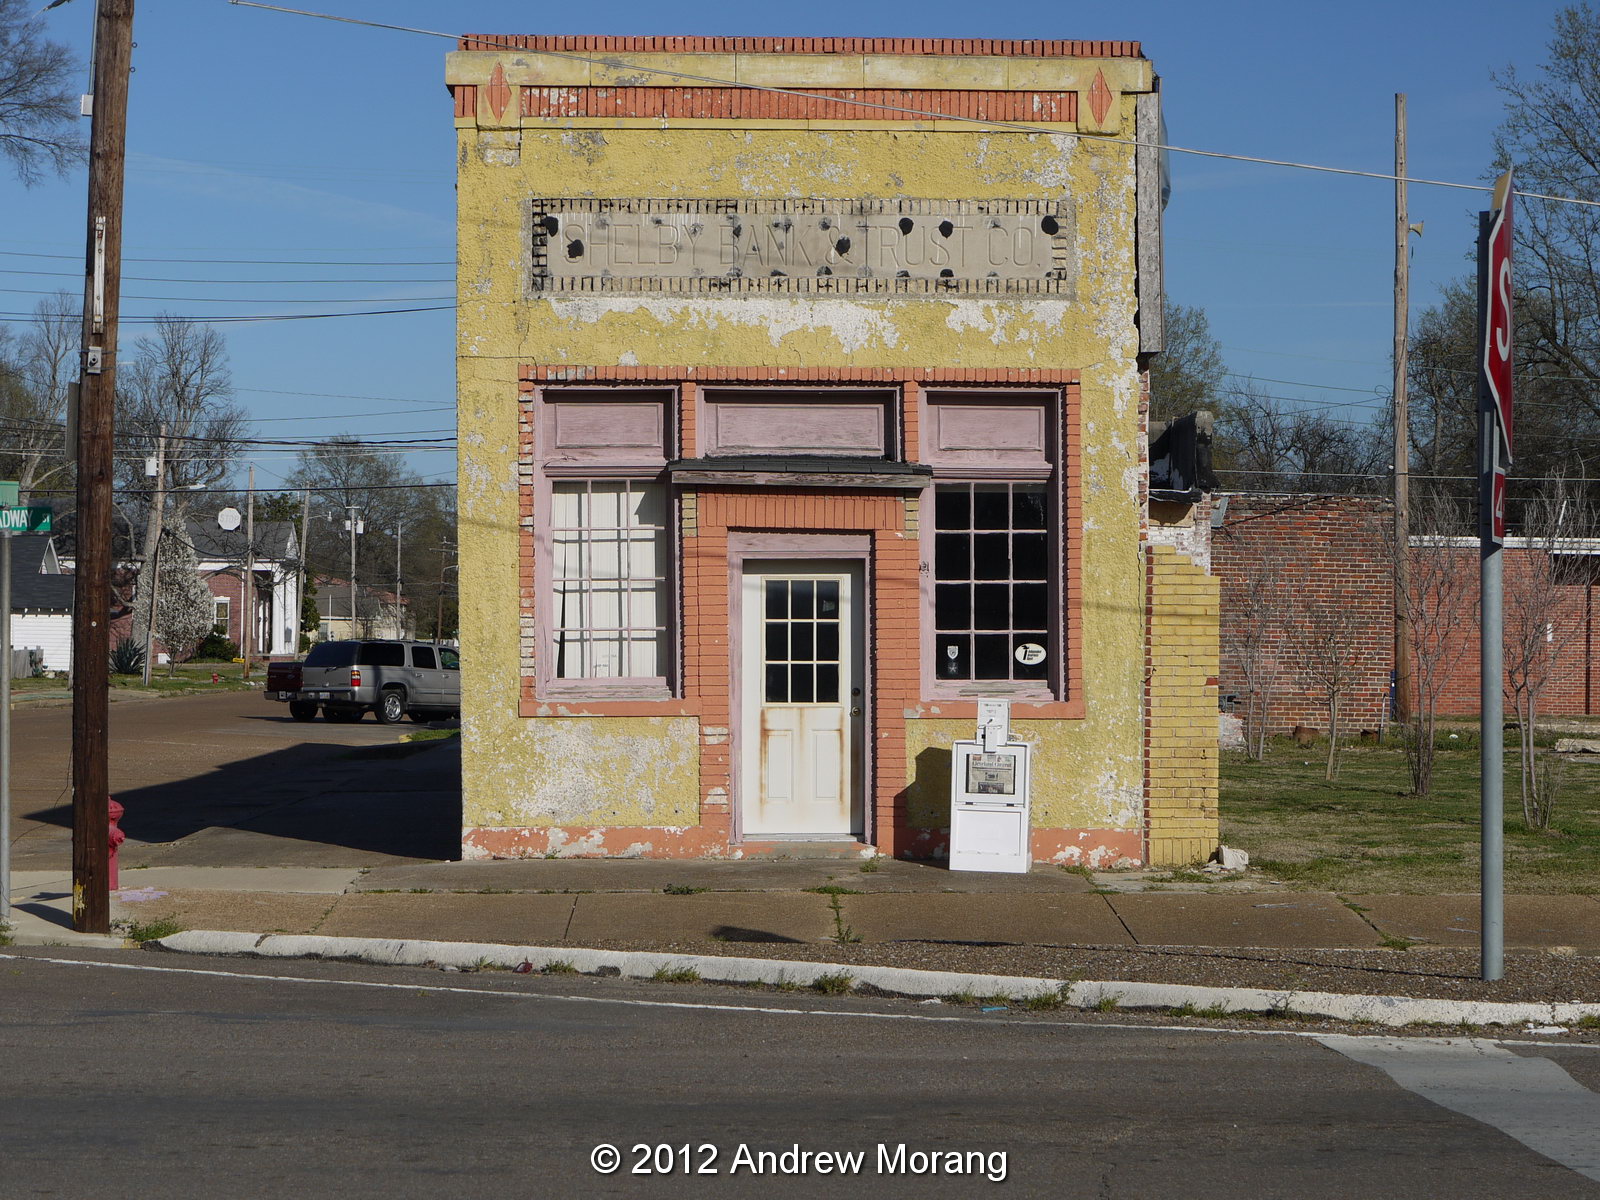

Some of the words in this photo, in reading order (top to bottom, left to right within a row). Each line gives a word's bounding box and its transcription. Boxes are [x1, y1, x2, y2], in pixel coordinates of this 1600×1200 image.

[563, 223, 704, 266] SHELBY
[719, 224, 814, 267] BANK
[825, 225, 853, 265] &
[856, 225, 974, 267] TRUST
[987, 226, 1041, 267] CO.
